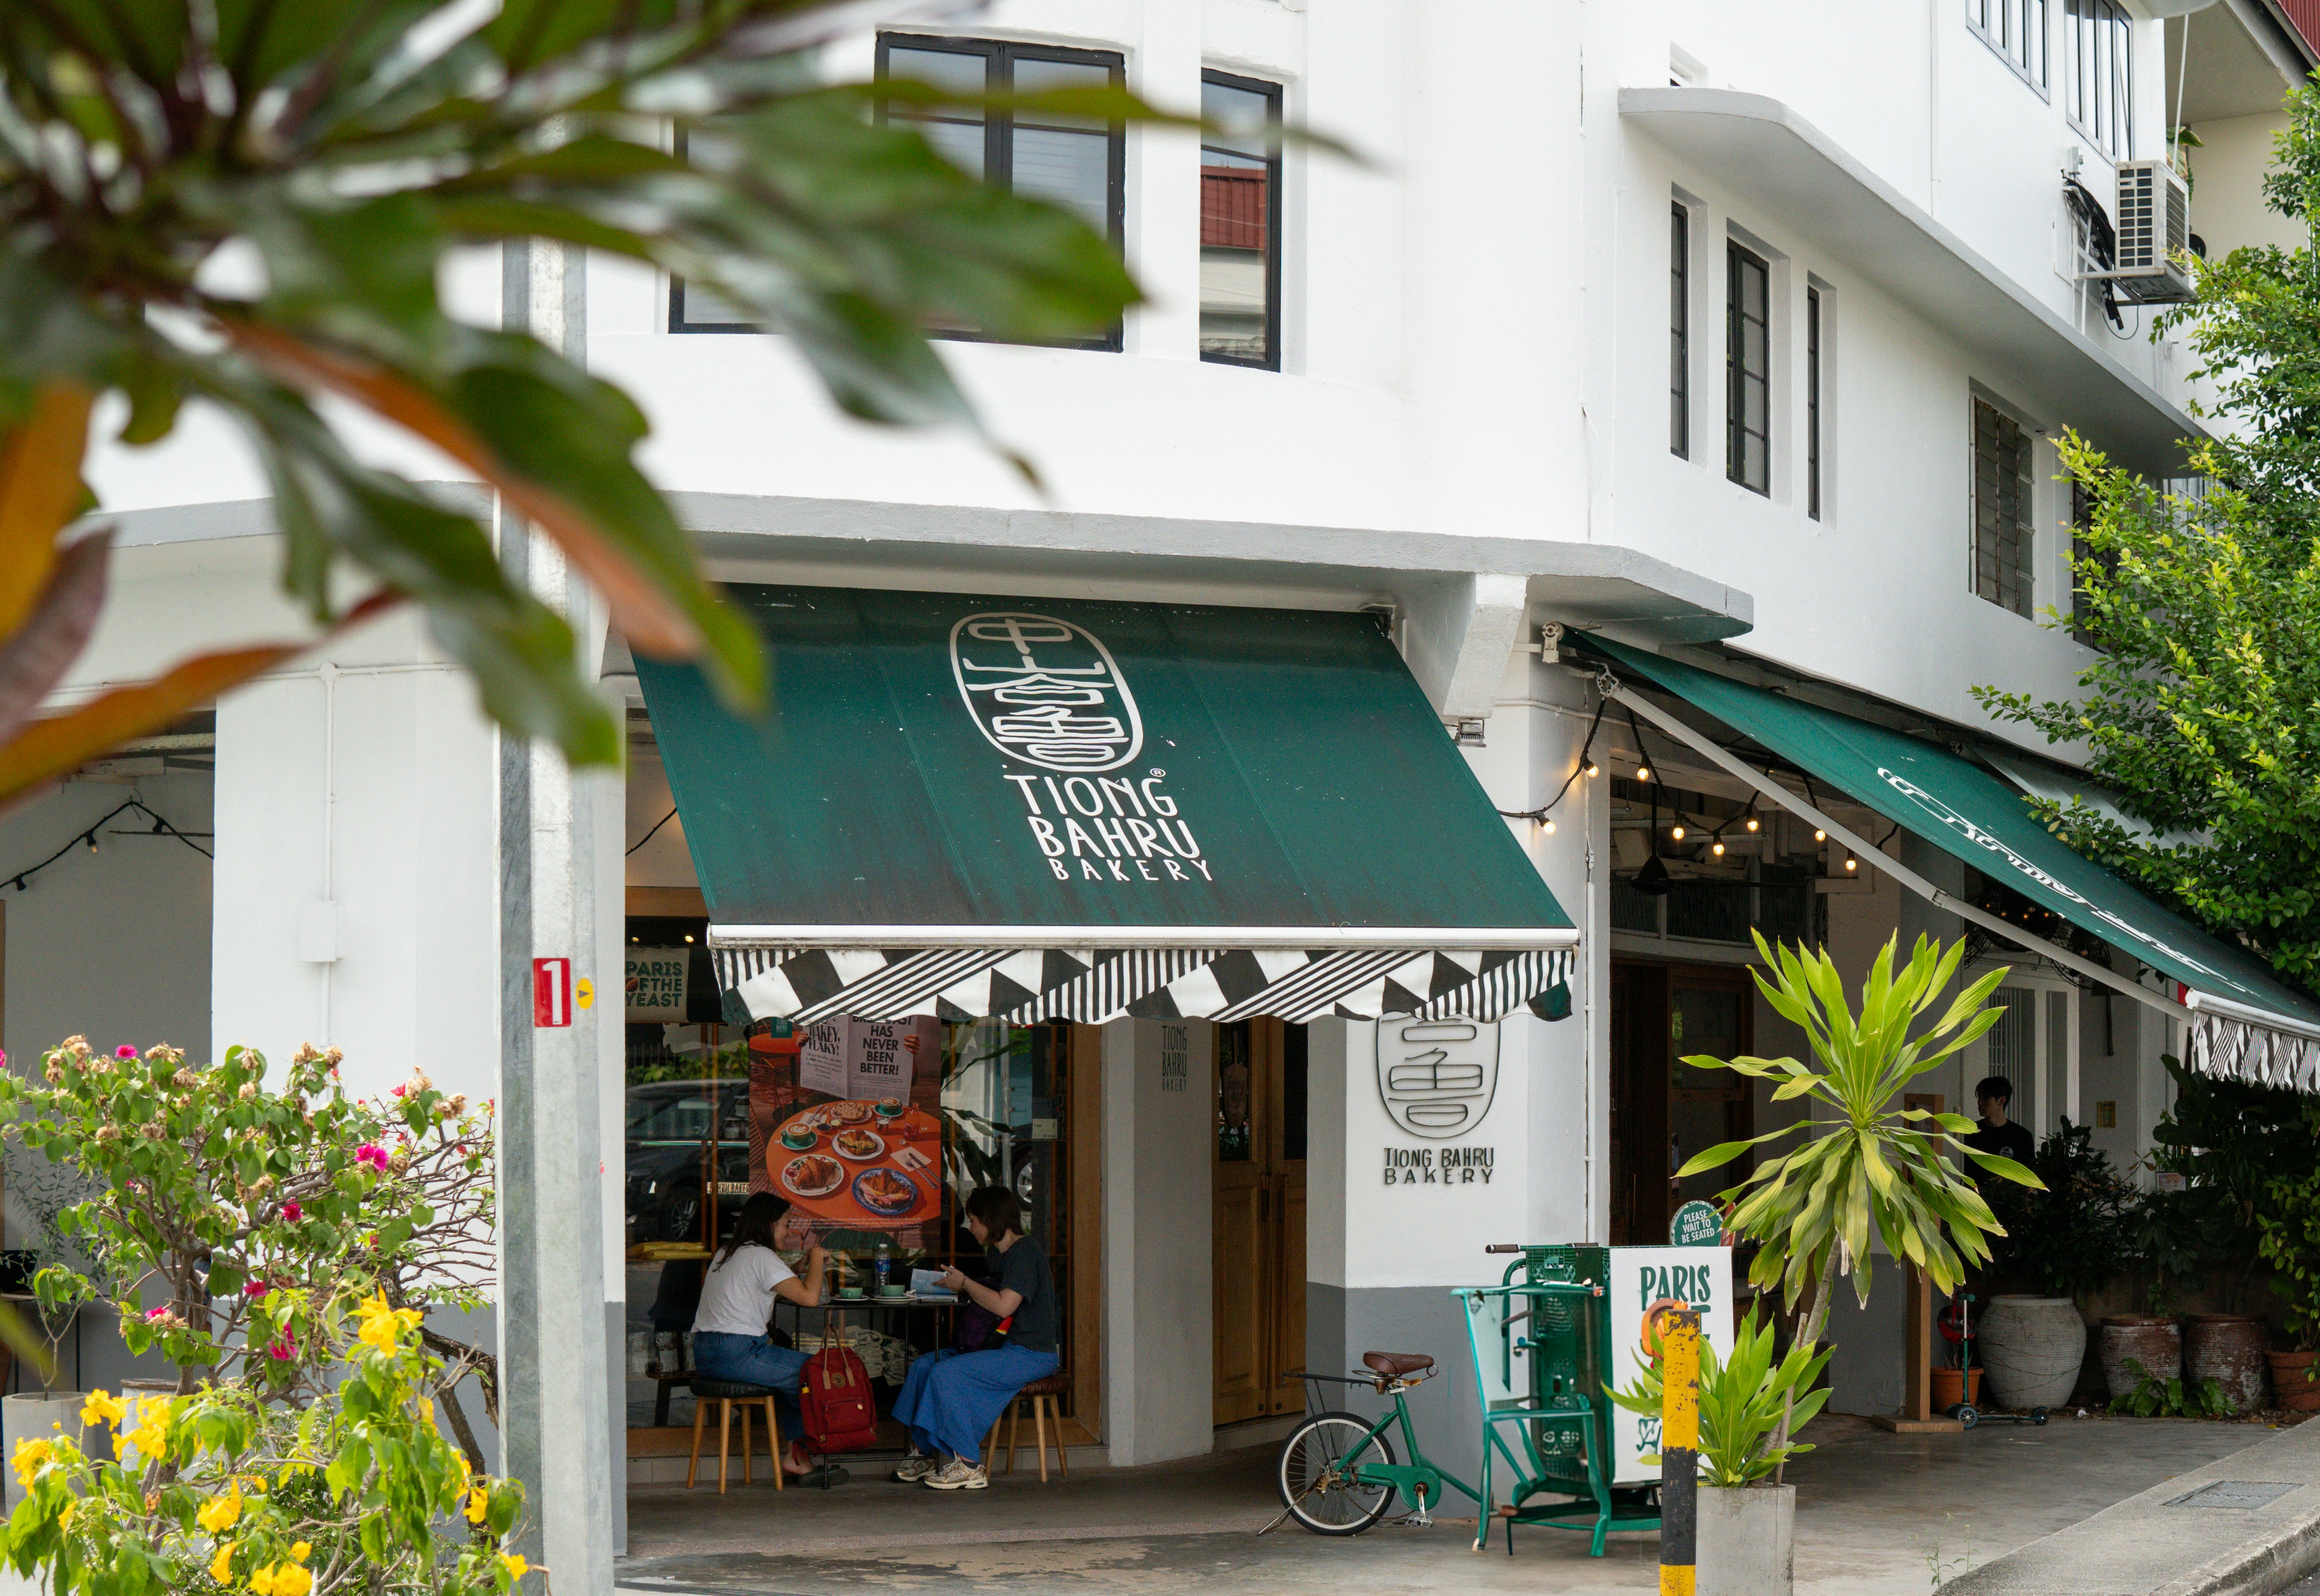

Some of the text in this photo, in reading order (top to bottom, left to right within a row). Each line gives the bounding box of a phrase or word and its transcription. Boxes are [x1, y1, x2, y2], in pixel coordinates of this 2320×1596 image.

[1003, 775, 1178, 817] TIONG
[1027, 815, 1200, 858] BAHRU
[1048, 858, 1212, 881] BAKERY
[625, 961, 683, 977] PARIS
[543, 960, 563, 1025] 1
[625, 993, 682, 1007] YEAST
[870, 1025, 893, 1038] HAS
[1162, 1025, 1187, 1051] TIONG
[809, 1039, 840, 1056] FLAKY!
[863, 1038, 899, 1051] NEVER
[867, 1051, 894, 1063] BEEN
[1162, 1052, 1187, 1077] BAHRU
[860, 1063, 899, 1075] BETTER!
[1162, 1078, 1187, 1092] BAKERY
[1384, 1147, 1494, 1168] TIONG BAHRU
[1384, 1167, 1493, 1185] BAKERY
[1684, 1209, 1707, 1223] PLEASE
[1682, 1218, 1711, 1233] WAIT TO
[1681, 1233, 1690, 1244] BE
[1691, 1227, 1715, 1241] SEATED
[1639, 1264, 1711, 1305] PARIS
